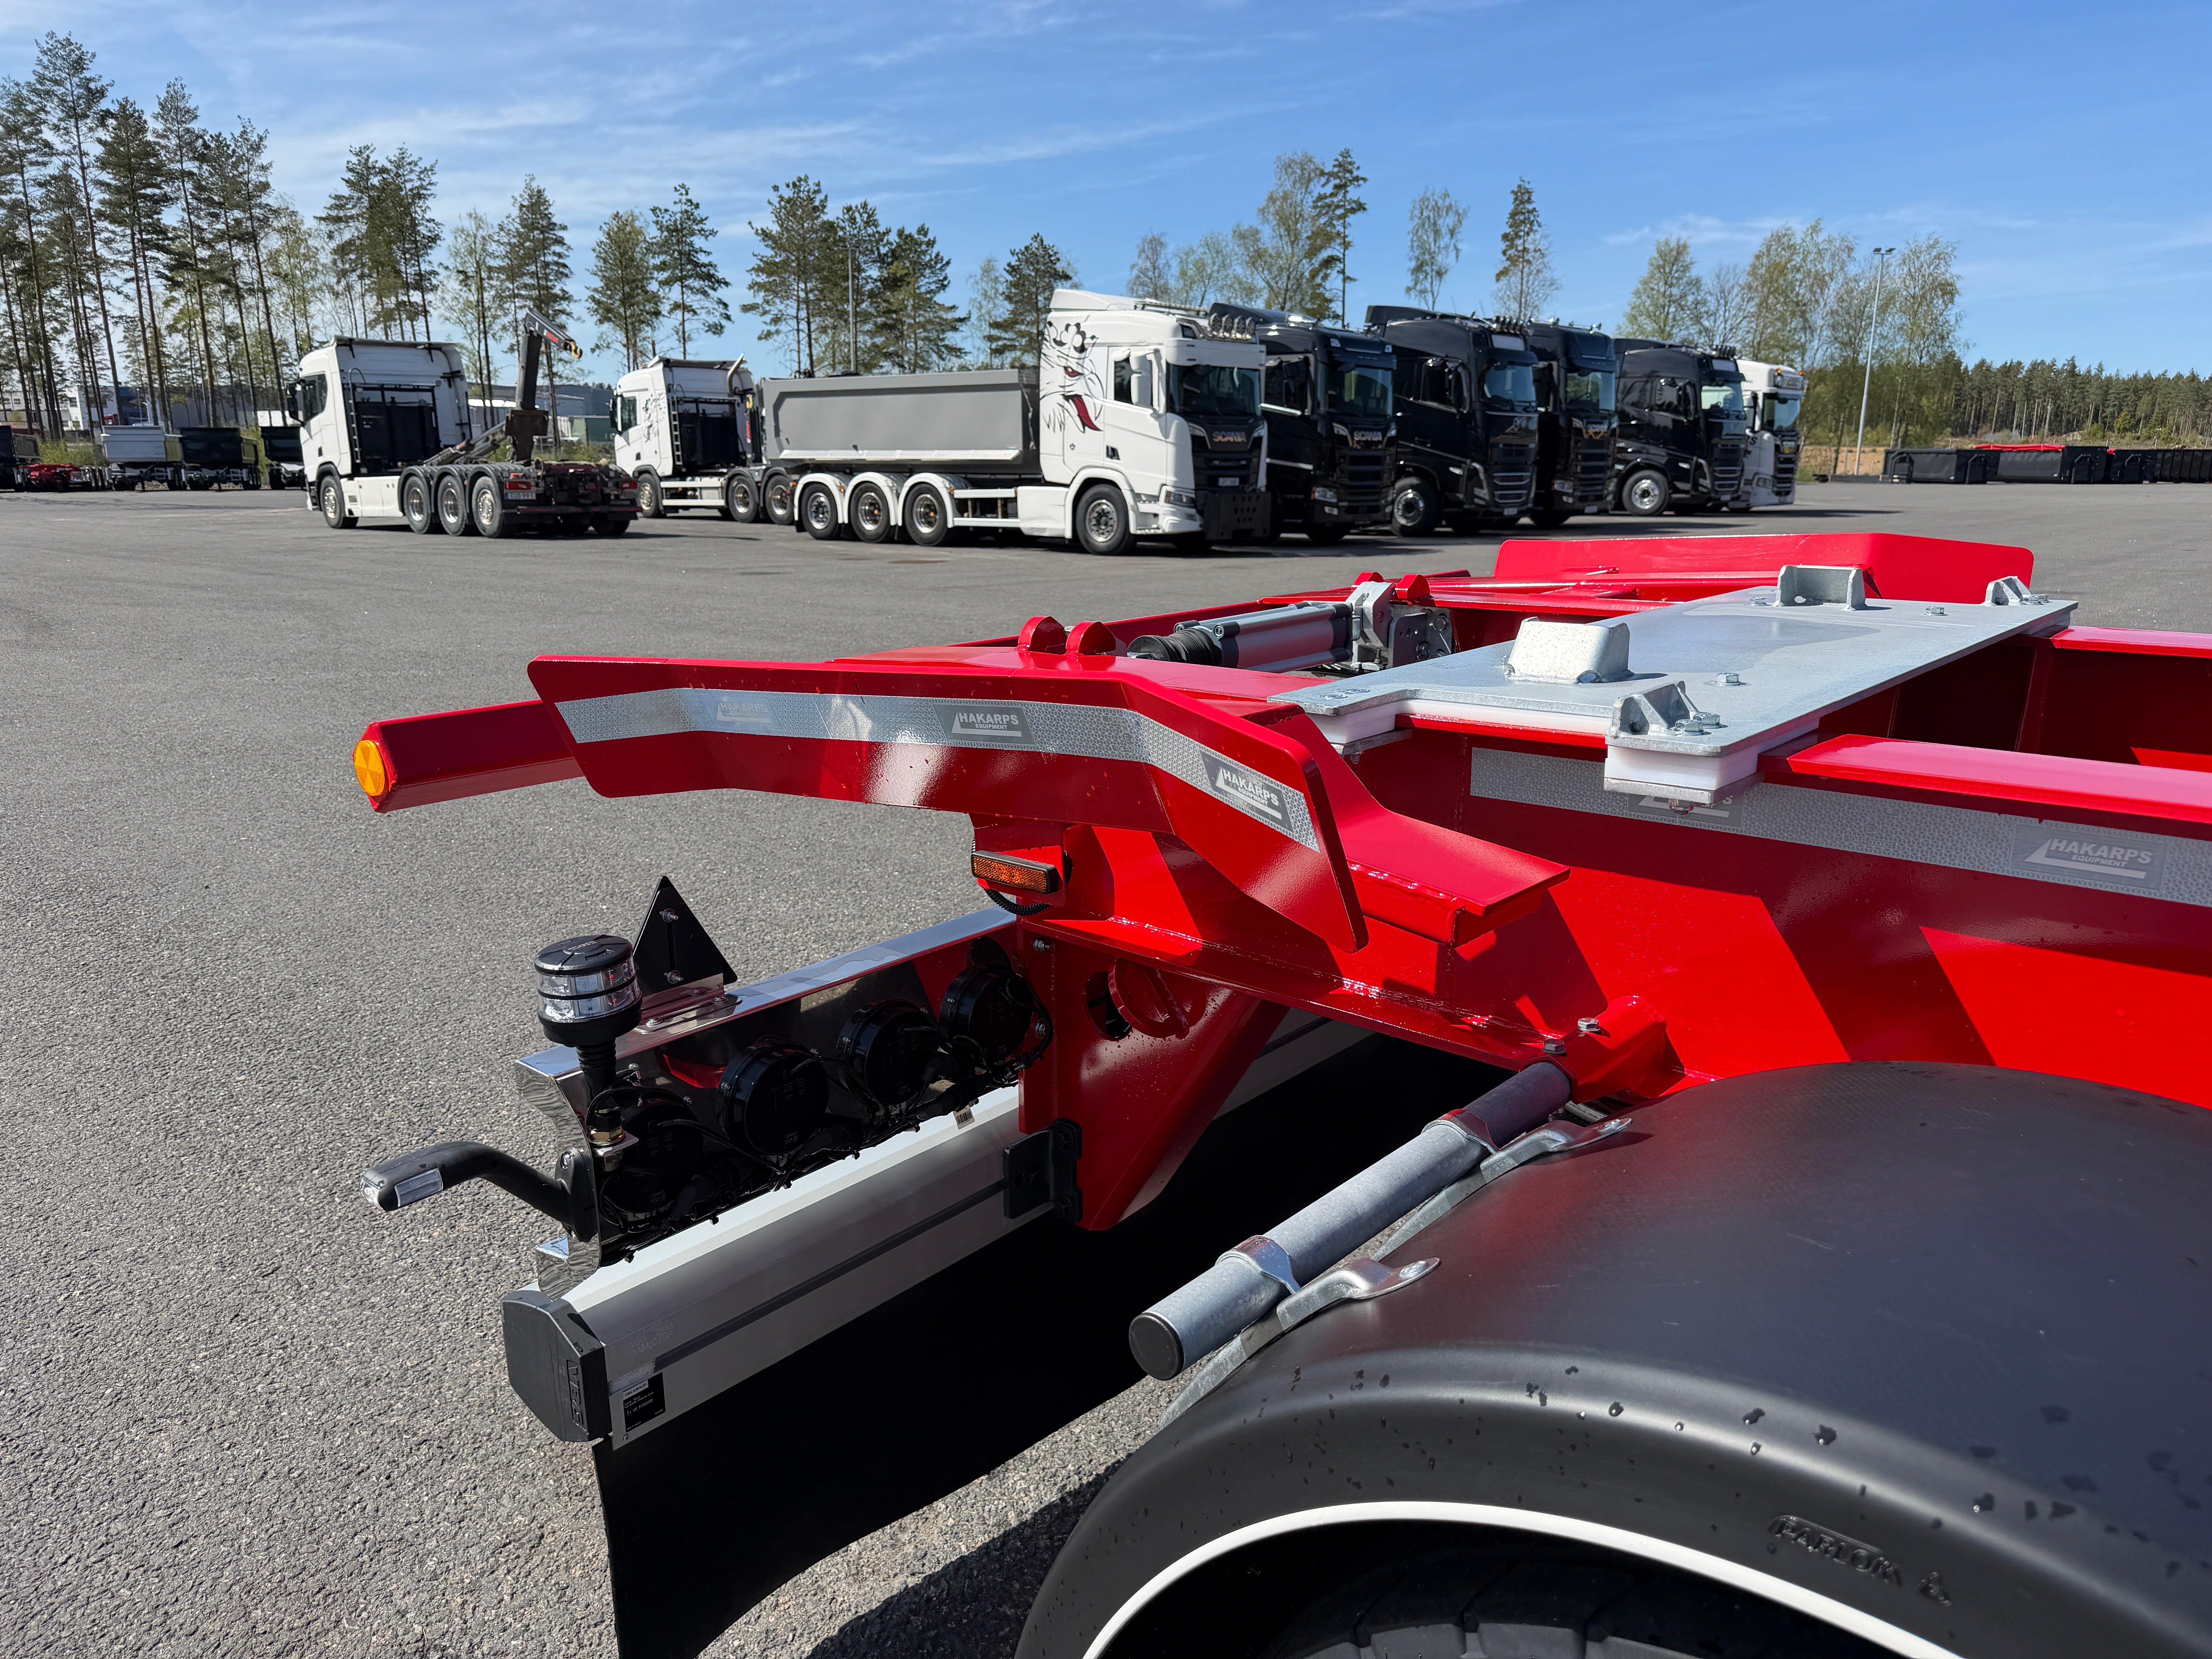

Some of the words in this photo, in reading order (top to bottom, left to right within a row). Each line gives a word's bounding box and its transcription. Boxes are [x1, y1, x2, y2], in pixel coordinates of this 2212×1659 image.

[720, 702, 768, 713] HAKARPS
[958, 713, 1019, 725] HAKARPS
[1222, 768, 1279, 806] HAKARPS
[1238, 787, 1268, 806] EQUIPMENT
[2050, 839, 2152, 864] HAKARPS
[2072, 854, 2128, 867] EQUIPMENT
